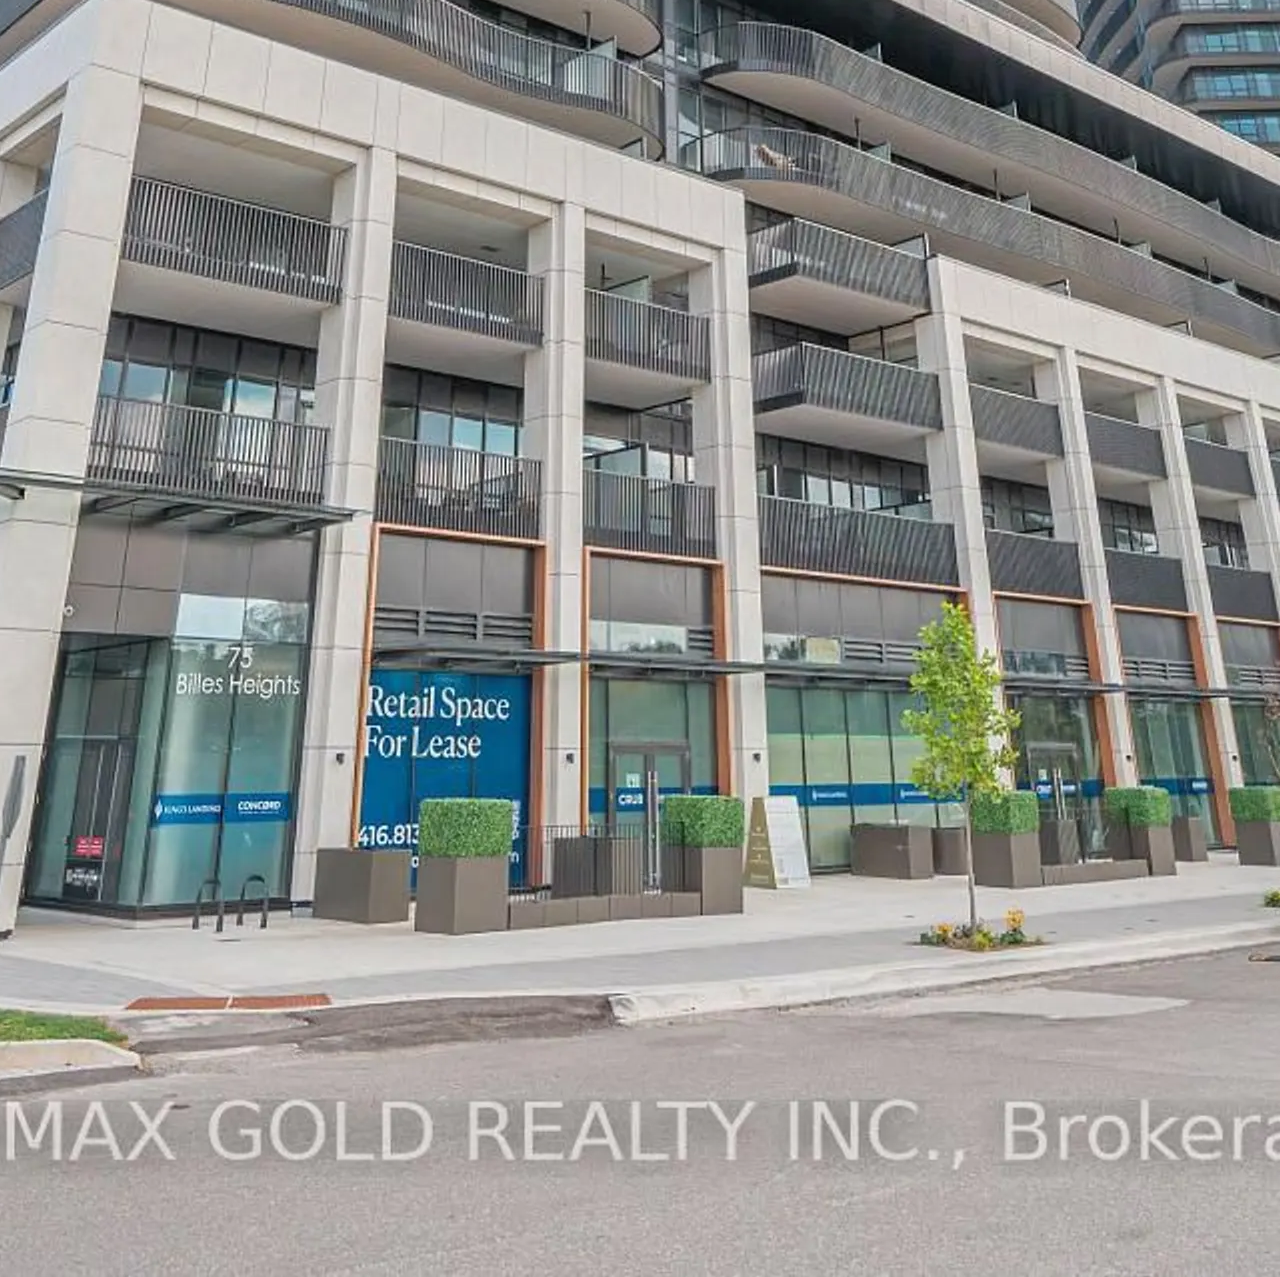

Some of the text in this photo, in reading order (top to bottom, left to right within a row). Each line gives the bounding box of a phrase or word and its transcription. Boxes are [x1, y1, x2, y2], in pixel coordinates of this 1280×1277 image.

[228, 646, 253, 669] 75
[176, 673, 301, 699] Billes Heights
[366, 685, 510, 726] Retail Space
[364, 724, 482, 758] For Lease
